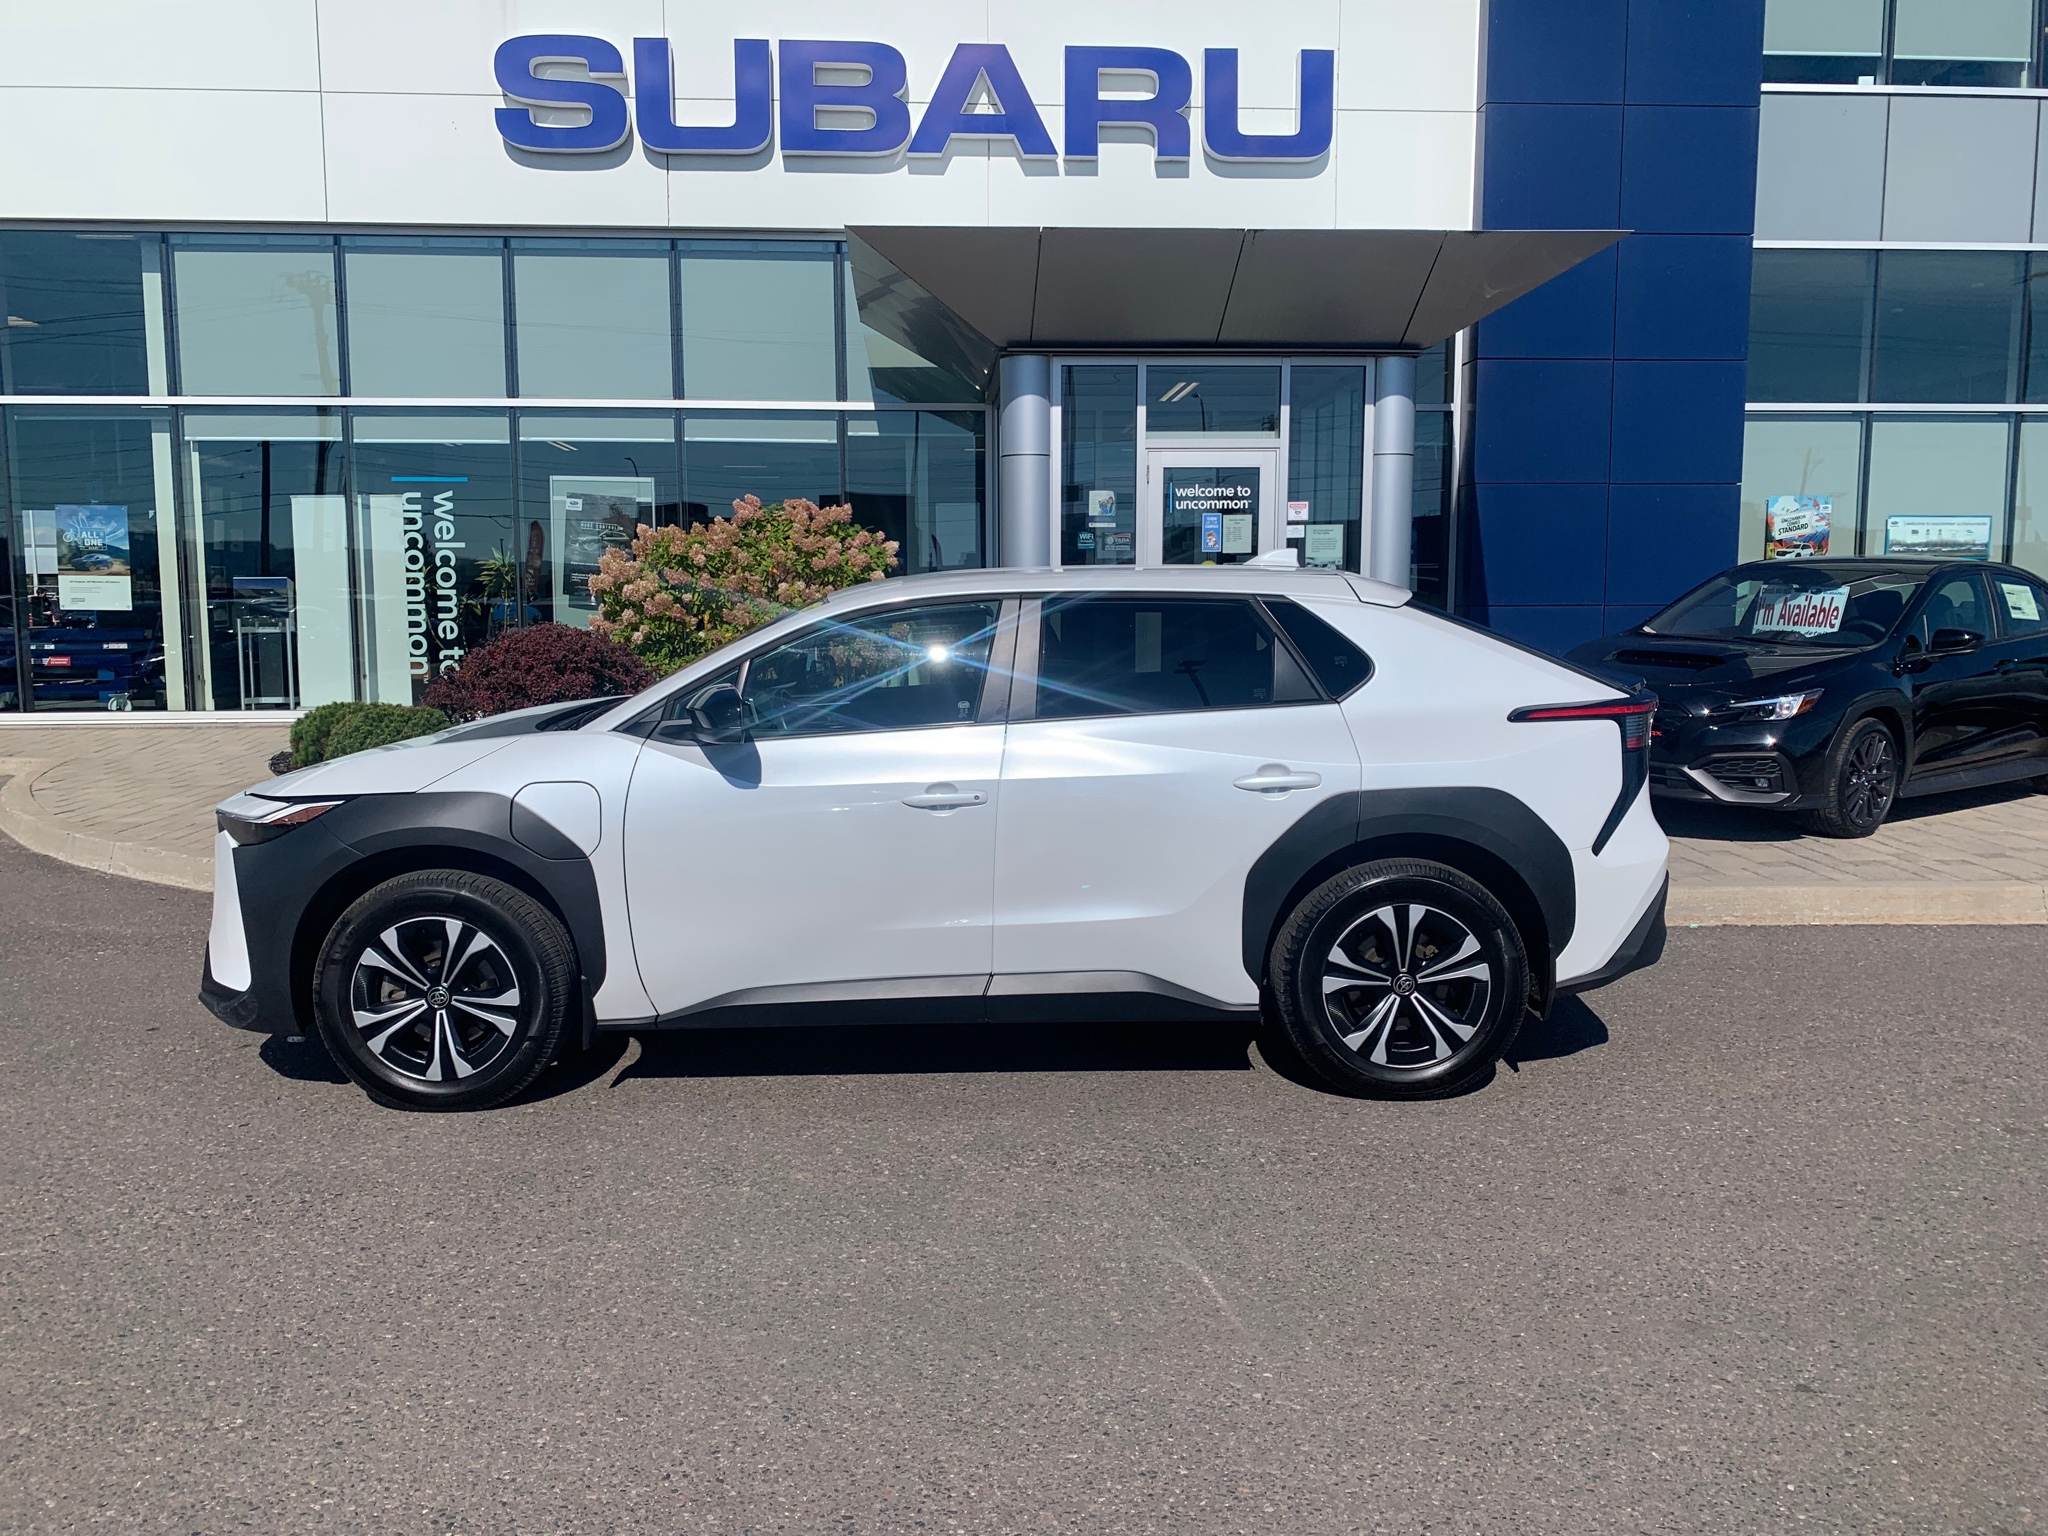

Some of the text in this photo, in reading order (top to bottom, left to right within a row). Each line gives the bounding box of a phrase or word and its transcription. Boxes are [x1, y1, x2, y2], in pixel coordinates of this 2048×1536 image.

[494, 35, 1335, 163] SUBARU
[1175, 484, 1251, 497] welcome to
[81, 531, 100, 539] ALL
[1778, 523, 1809, 536] STANDARD
[84, 538, 103, 546] ONE
[433, 490, 466, 640] welcome
[1755, 595, 1840, 629] I'm Available
